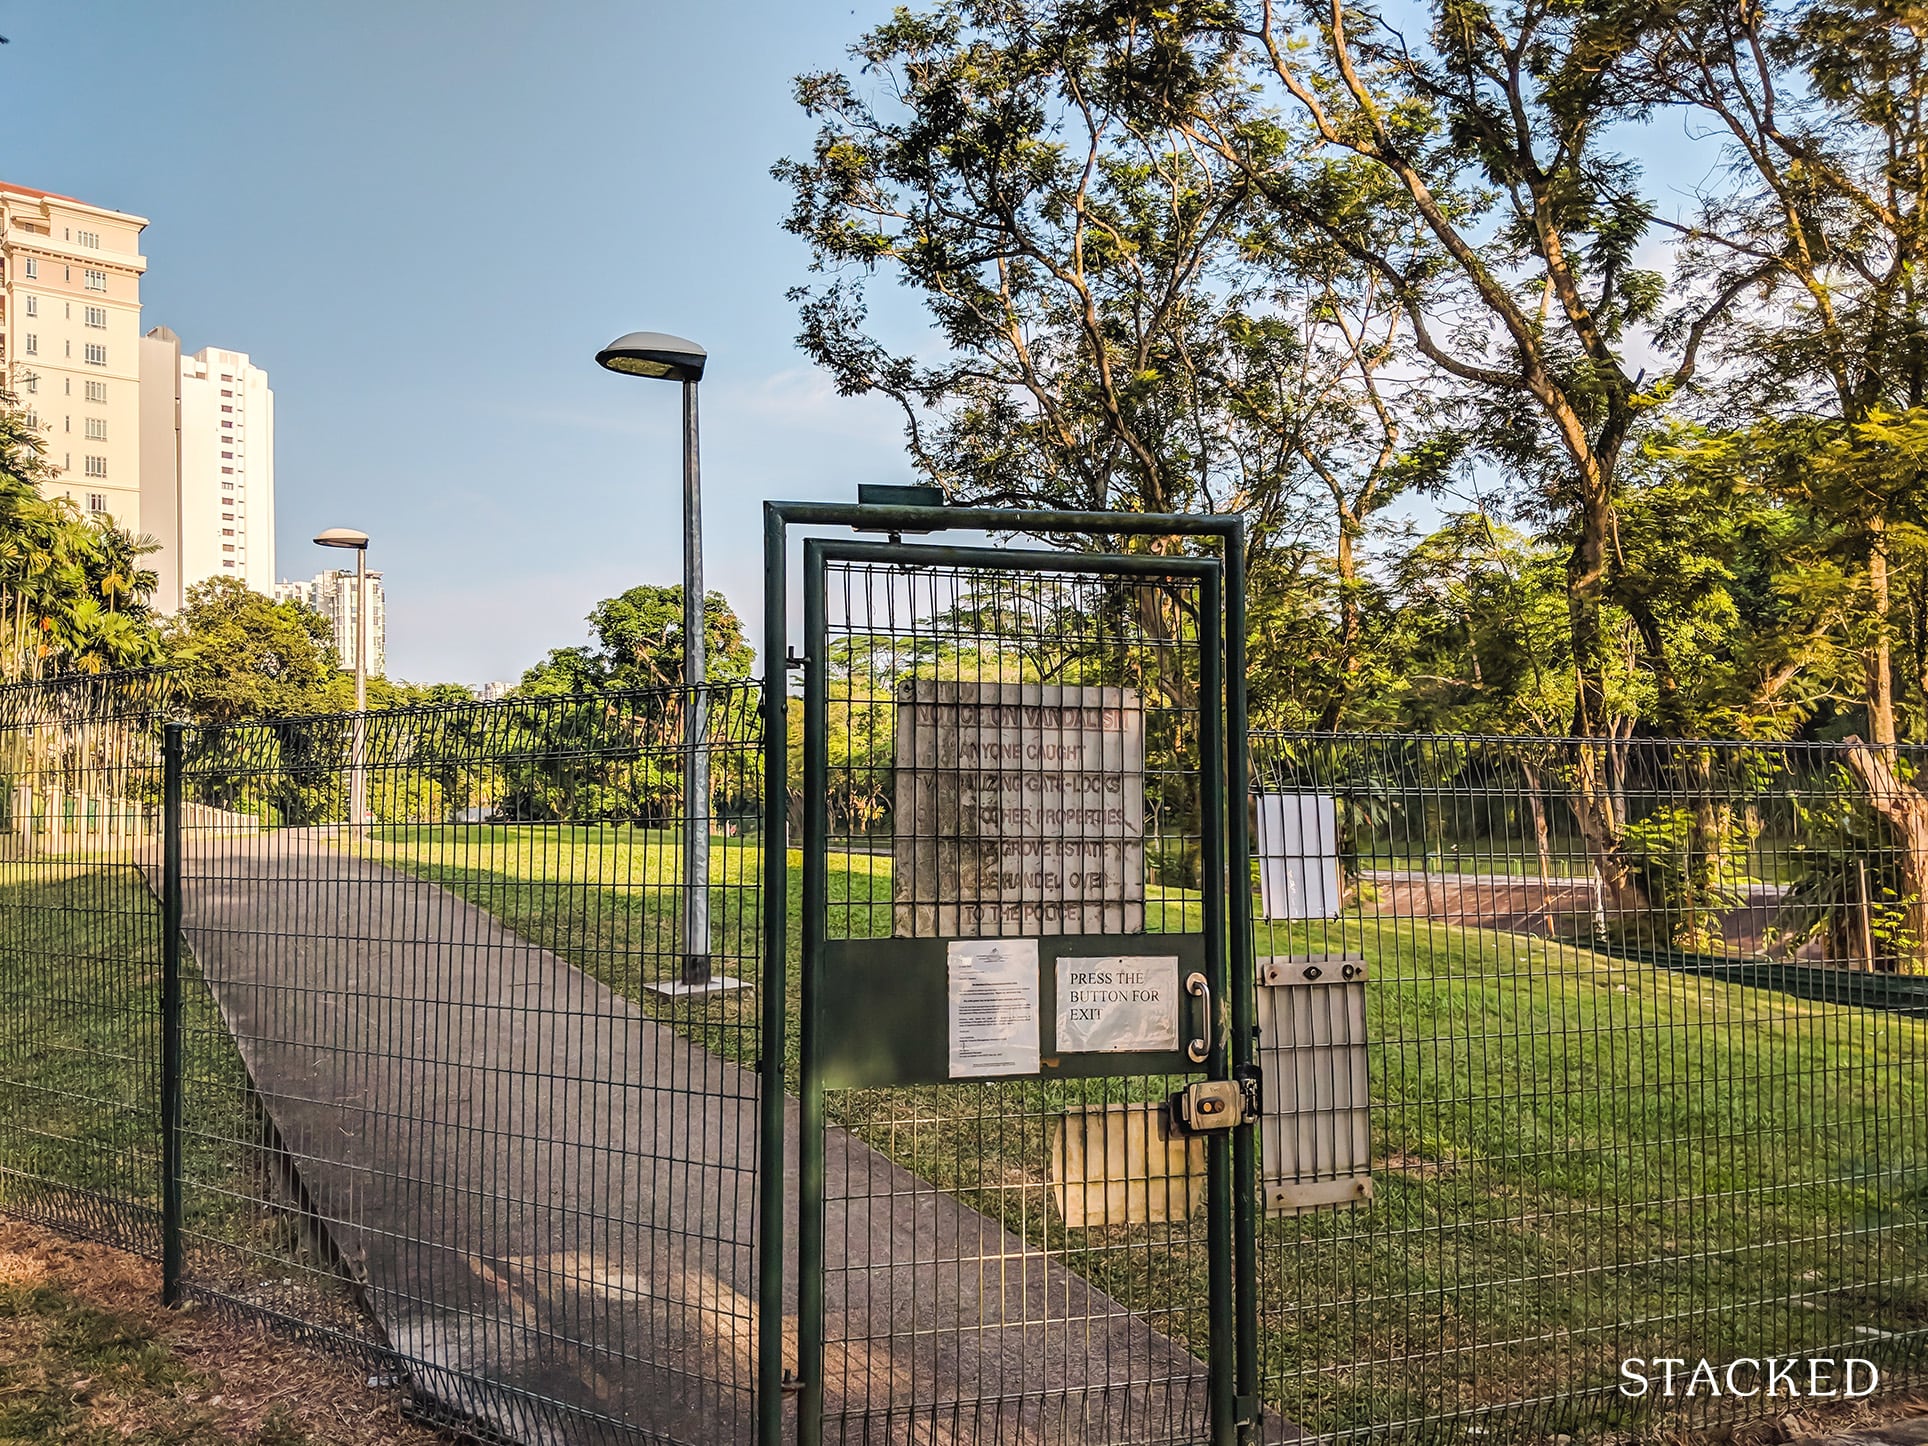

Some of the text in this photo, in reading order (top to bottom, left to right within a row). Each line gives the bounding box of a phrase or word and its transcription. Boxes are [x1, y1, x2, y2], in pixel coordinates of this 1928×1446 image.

[917, 705, 1128, 729] NOTCE ON VANDALSM
[959, 743, 1086, 761] ANYONE CAUGHT
[924, 774, 1120, 793] VALIZNG GATE-LOCKS
[1037, 809, 1123, 825] PROPERTIES
[1002, 840, 1051, 856] GROVE
[1056, 841, 1109, 857] ESTATE
[1070, 872, 1108, 889] OVER
[965, 906, 985, 923] TO
[990, 905, 1019, 921] THE
[1070, 972, 1144, 985] PRESS THE
[1070, 990, 1160, 1003] BUTTON FOR
[1070, 1008, 1103, 1021] EXIT
